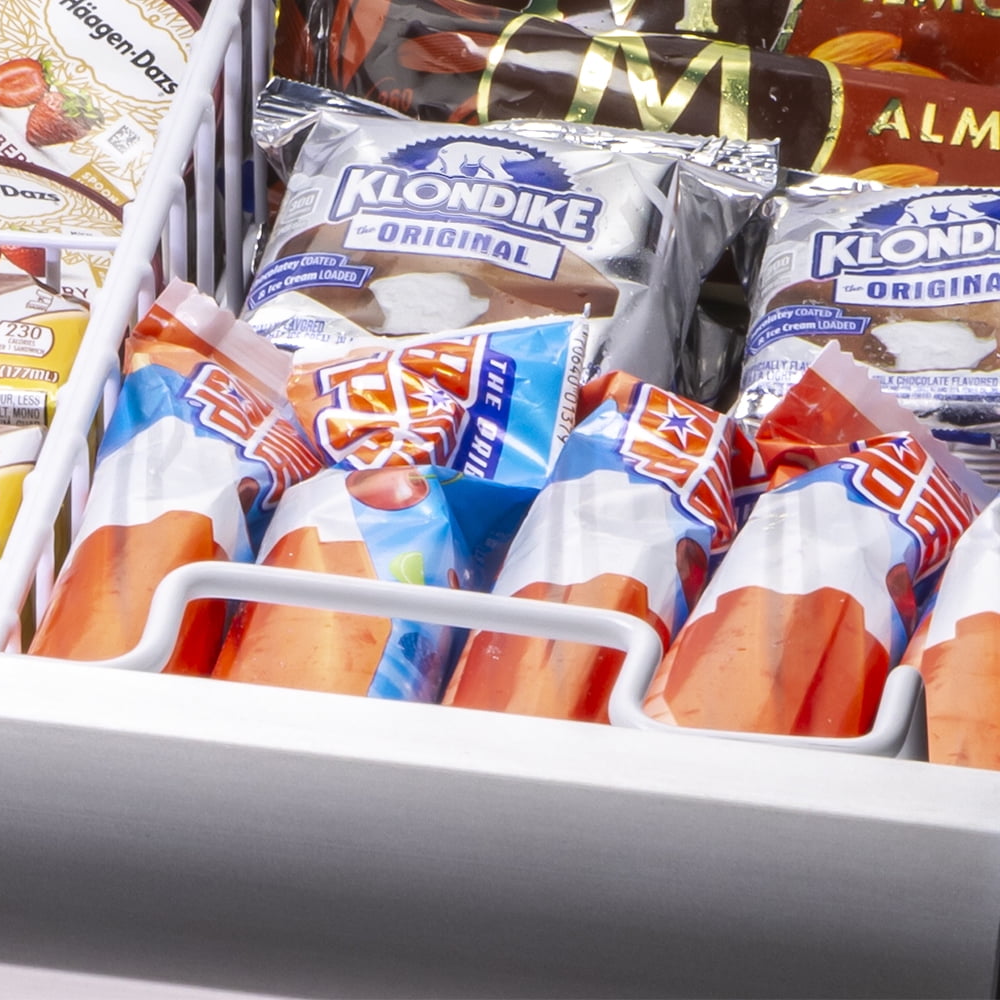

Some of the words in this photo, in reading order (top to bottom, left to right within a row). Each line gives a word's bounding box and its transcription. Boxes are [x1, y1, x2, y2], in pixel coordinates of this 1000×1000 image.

[335, 166, 596, 239] KLONDIKE
[377, 221, 529, 266] ORIGINAL
[300, 256, 337, 267] COATED
[267, 281, 282, 293] Ice
[284, 272, 317, 285] Cream
[318, 269, 357, 282] LOADED
[795, 308, 832, 317] COATED
[5, 323, 42, 340] 230
[766, 327, 781, 338] Ice
[782, 321, 816, 331] Cream
[817, 320, 856, 330] LOADED
[485, 358, 507, 411] THE
[896, 376, 949, 386] CHOCOLATE
[17, 395, 41, 406] LESS
[12, 407, 41, 419] MONO
